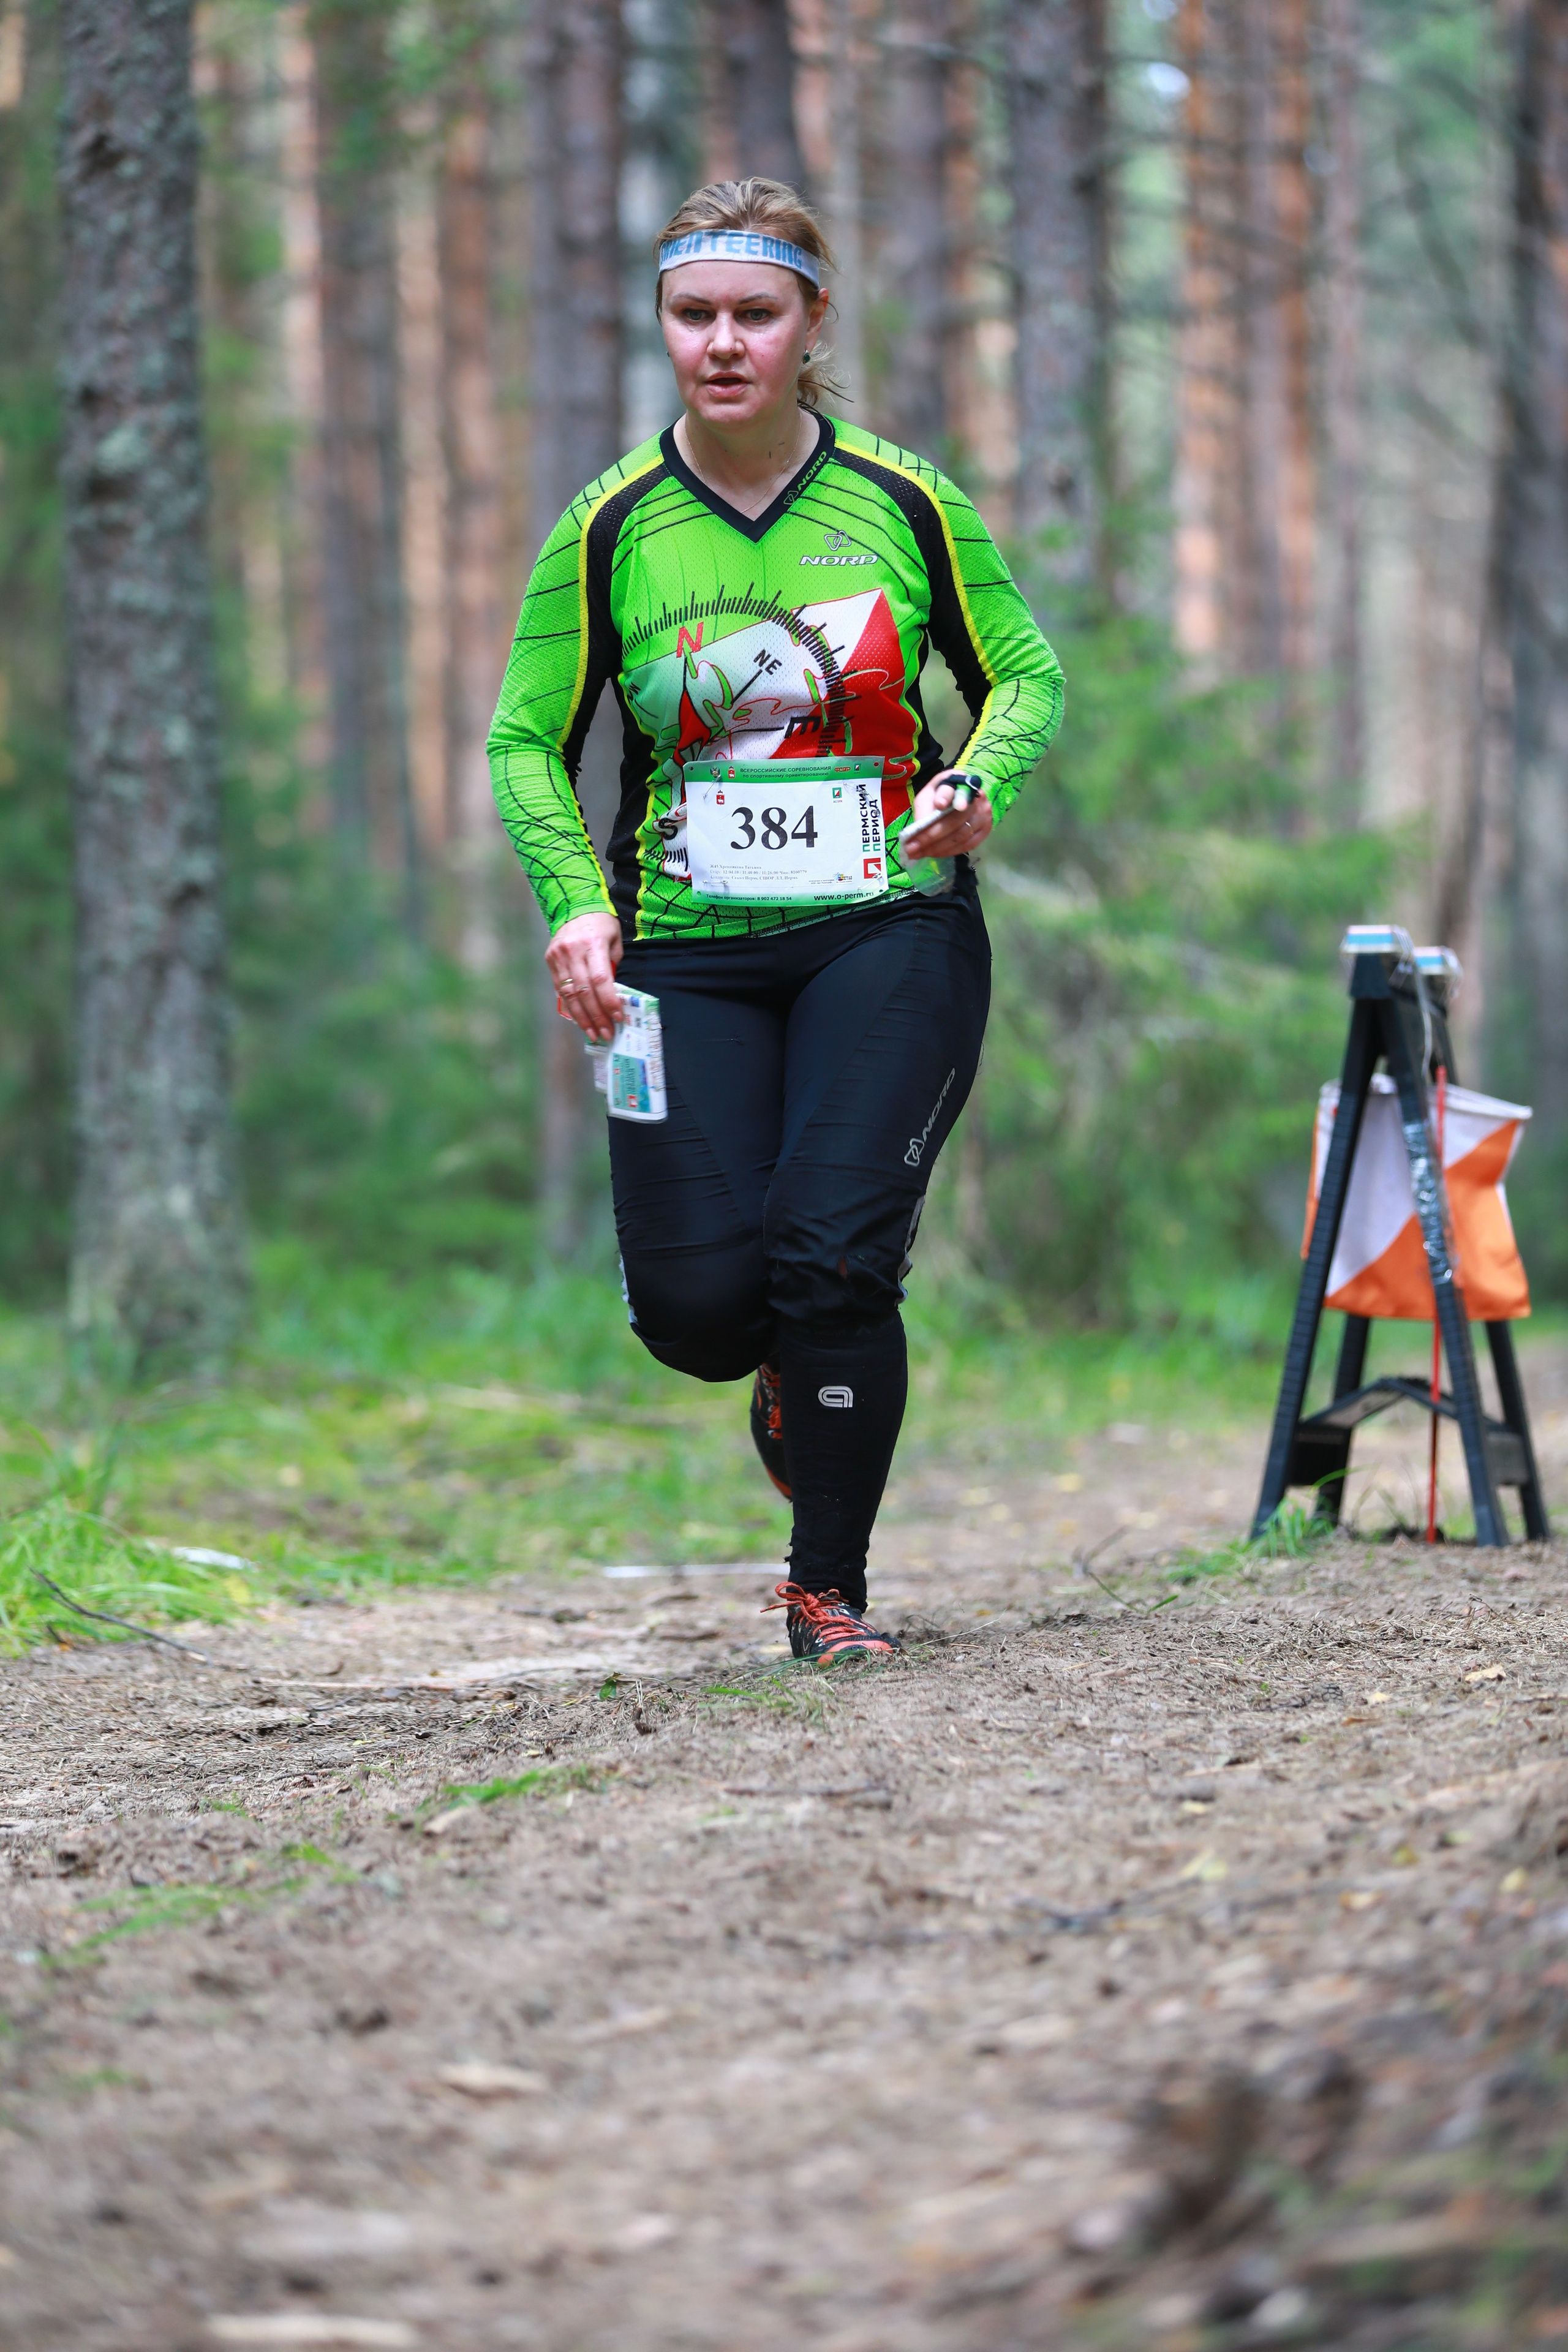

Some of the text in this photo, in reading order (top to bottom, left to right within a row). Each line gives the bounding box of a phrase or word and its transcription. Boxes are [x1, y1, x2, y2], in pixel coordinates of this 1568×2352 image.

[660, 228, 802, 270] RIENTEERING
[797, 451, 827, 491] NORD
[799, 553, 878, 567] NORD
[676, 622, 704, 658] N
[753, 649, 782, 676] NE
[730, 805, 818, 850] 384
[856, 784, 870, 853] ПЕРМСКИЙ
[869, 799, 881, 851] ПЕРИОД
[814, 892, 873, 900] www.o-perm.ru
[922, 1068, 955, 1142] NORD
